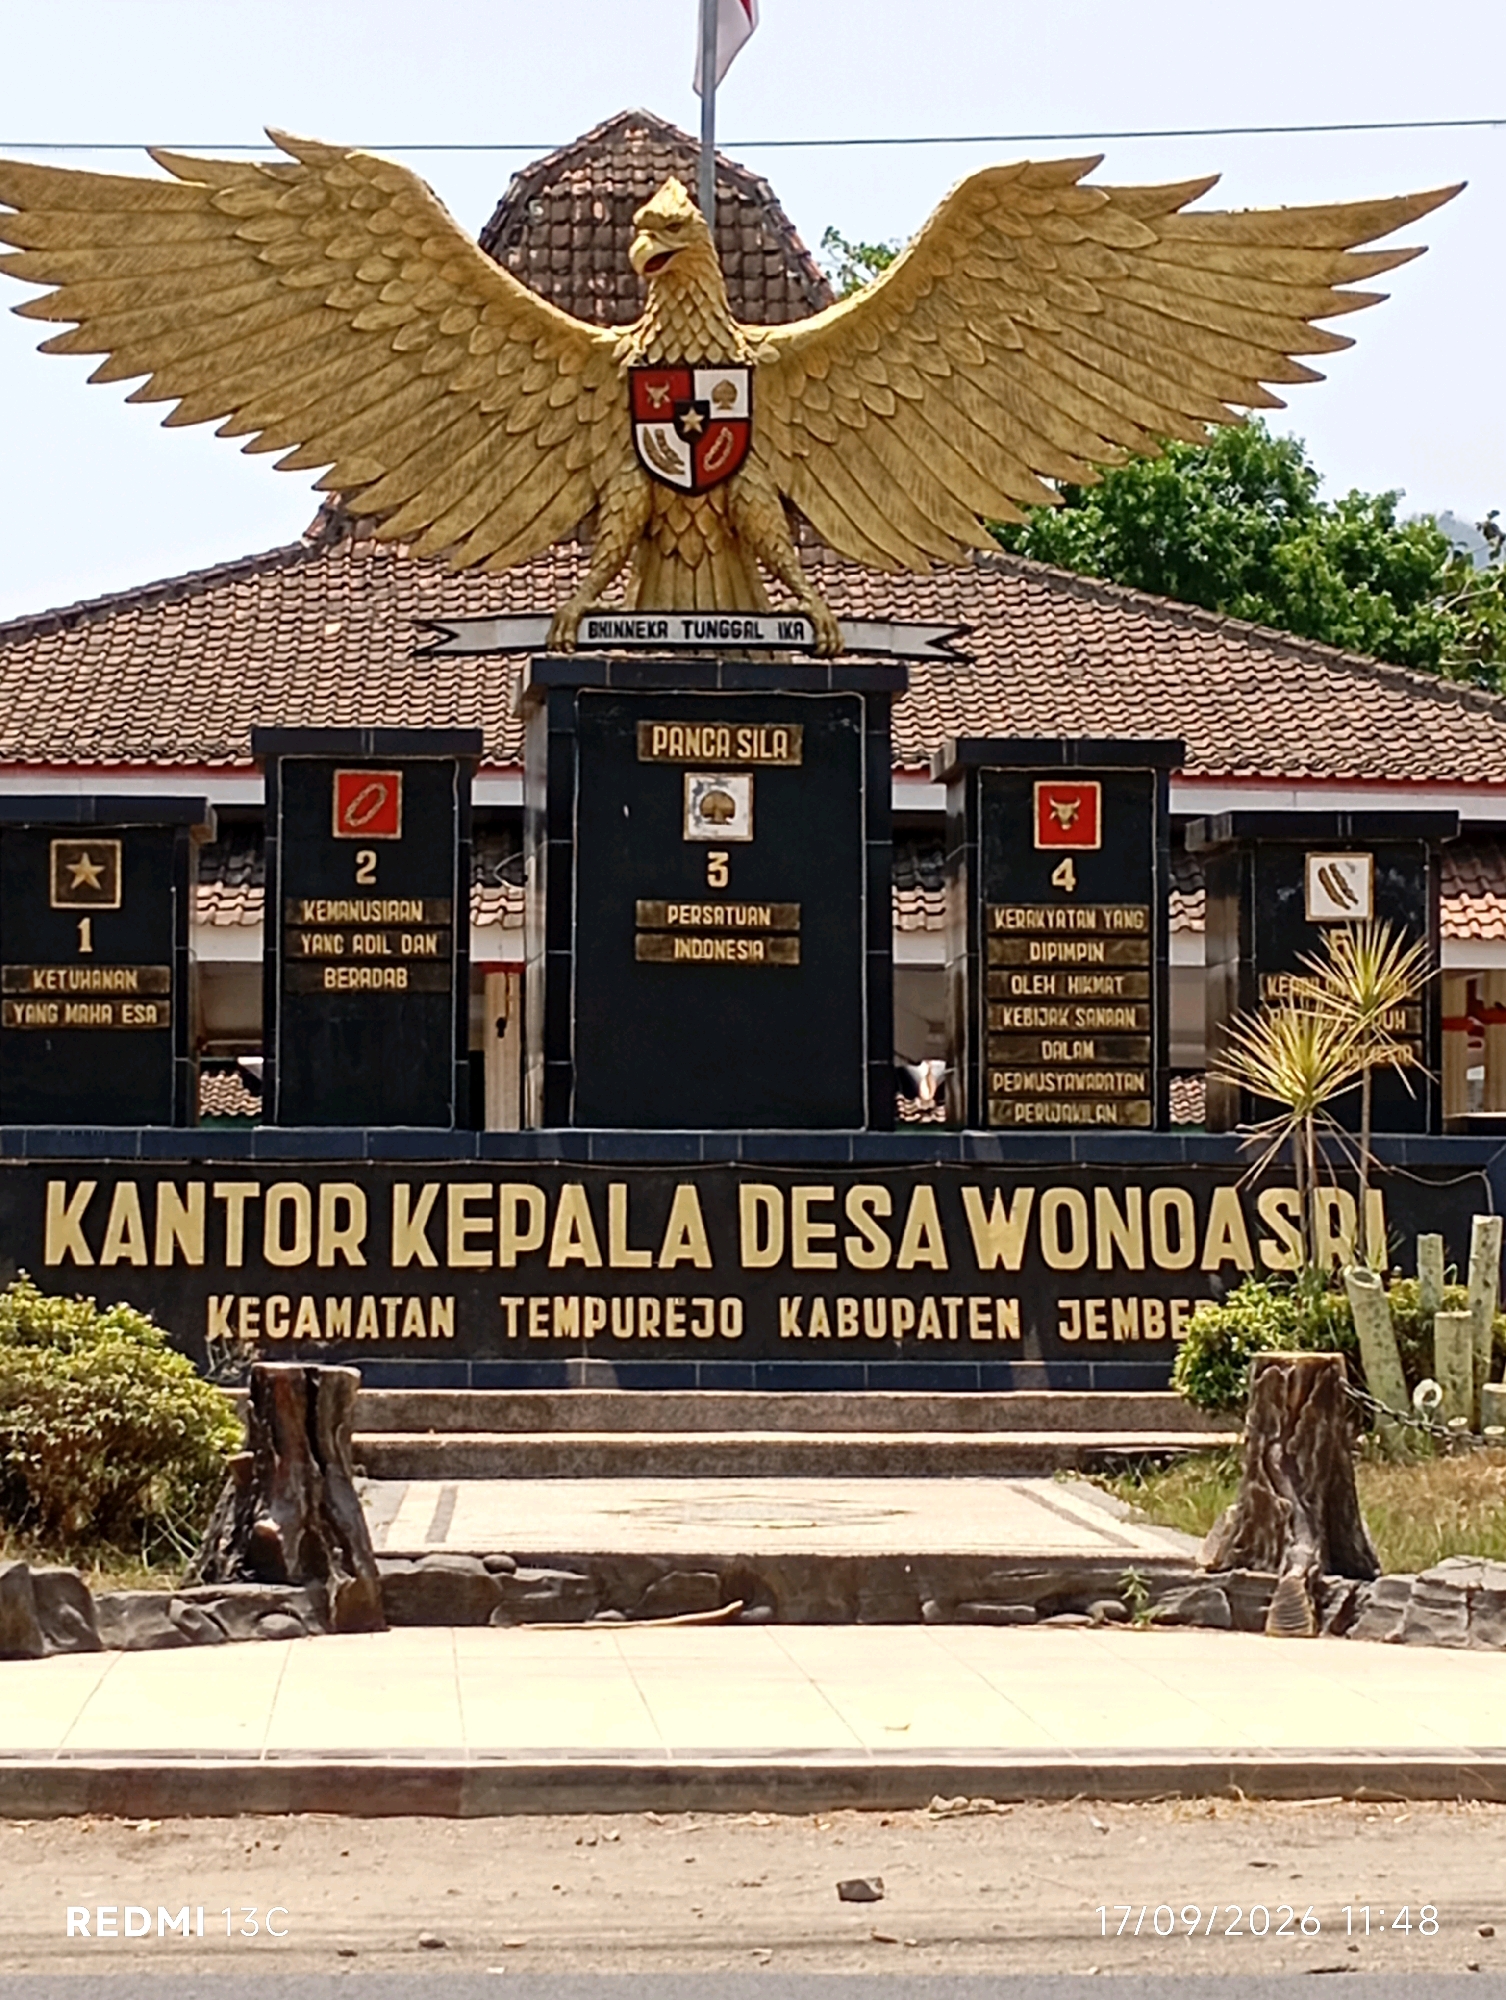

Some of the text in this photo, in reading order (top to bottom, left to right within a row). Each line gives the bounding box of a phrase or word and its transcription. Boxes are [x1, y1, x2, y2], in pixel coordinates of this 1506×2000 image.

[588, 619, 805, 641] BHINNEKA TUNGGAL IKA
[652, 725, 788, 759] PANCA SILA
[355, 849, 377, 885] 2
[707, 851, 729, 888] 3
[1050, 856, 1077, 892] 4
[303, 900, 424, 922] KEMANUSIAAN
[667, 904, 772, 927] PERSATUAN
[994, 908, 1145, 930] KERAKYATAN YANG
[77, 916, 93, 952] 1
[352, 933, 393, 955] ADIL
[401, 933, 438, 955] DAN
[673, 937, 765, 961] INDONESIA
[1029, 940, 1105, 962] DIPIMPIN
[32, 968, 139, 991] KETUHANAN
[324, 966, 408, 989] BERADAB
[1010, 974, 1126, 996] OLEH HIKMAT
[12, 1003, 158, 1025] YANG MAHA ESA
[1003, 1006, 1137, 1028] KEBIJAK SANAAN
[1041, 1040, 1095, 1060] DALAM
[992, 1071, 1146, 1092] PERMUSYAWARATAN
[1014, 1102, 1118, 1124] PERWAKILAN
[44, 1180, 1389, 1272] KANTOR KEPALA DESA WONOASRI
[205, 1294, 457, 1341] KECAMATAN
[500, 1296, 744, 1340] TEMPUREJO
[779, 1296, 1021, 1341] KABUPATEN
